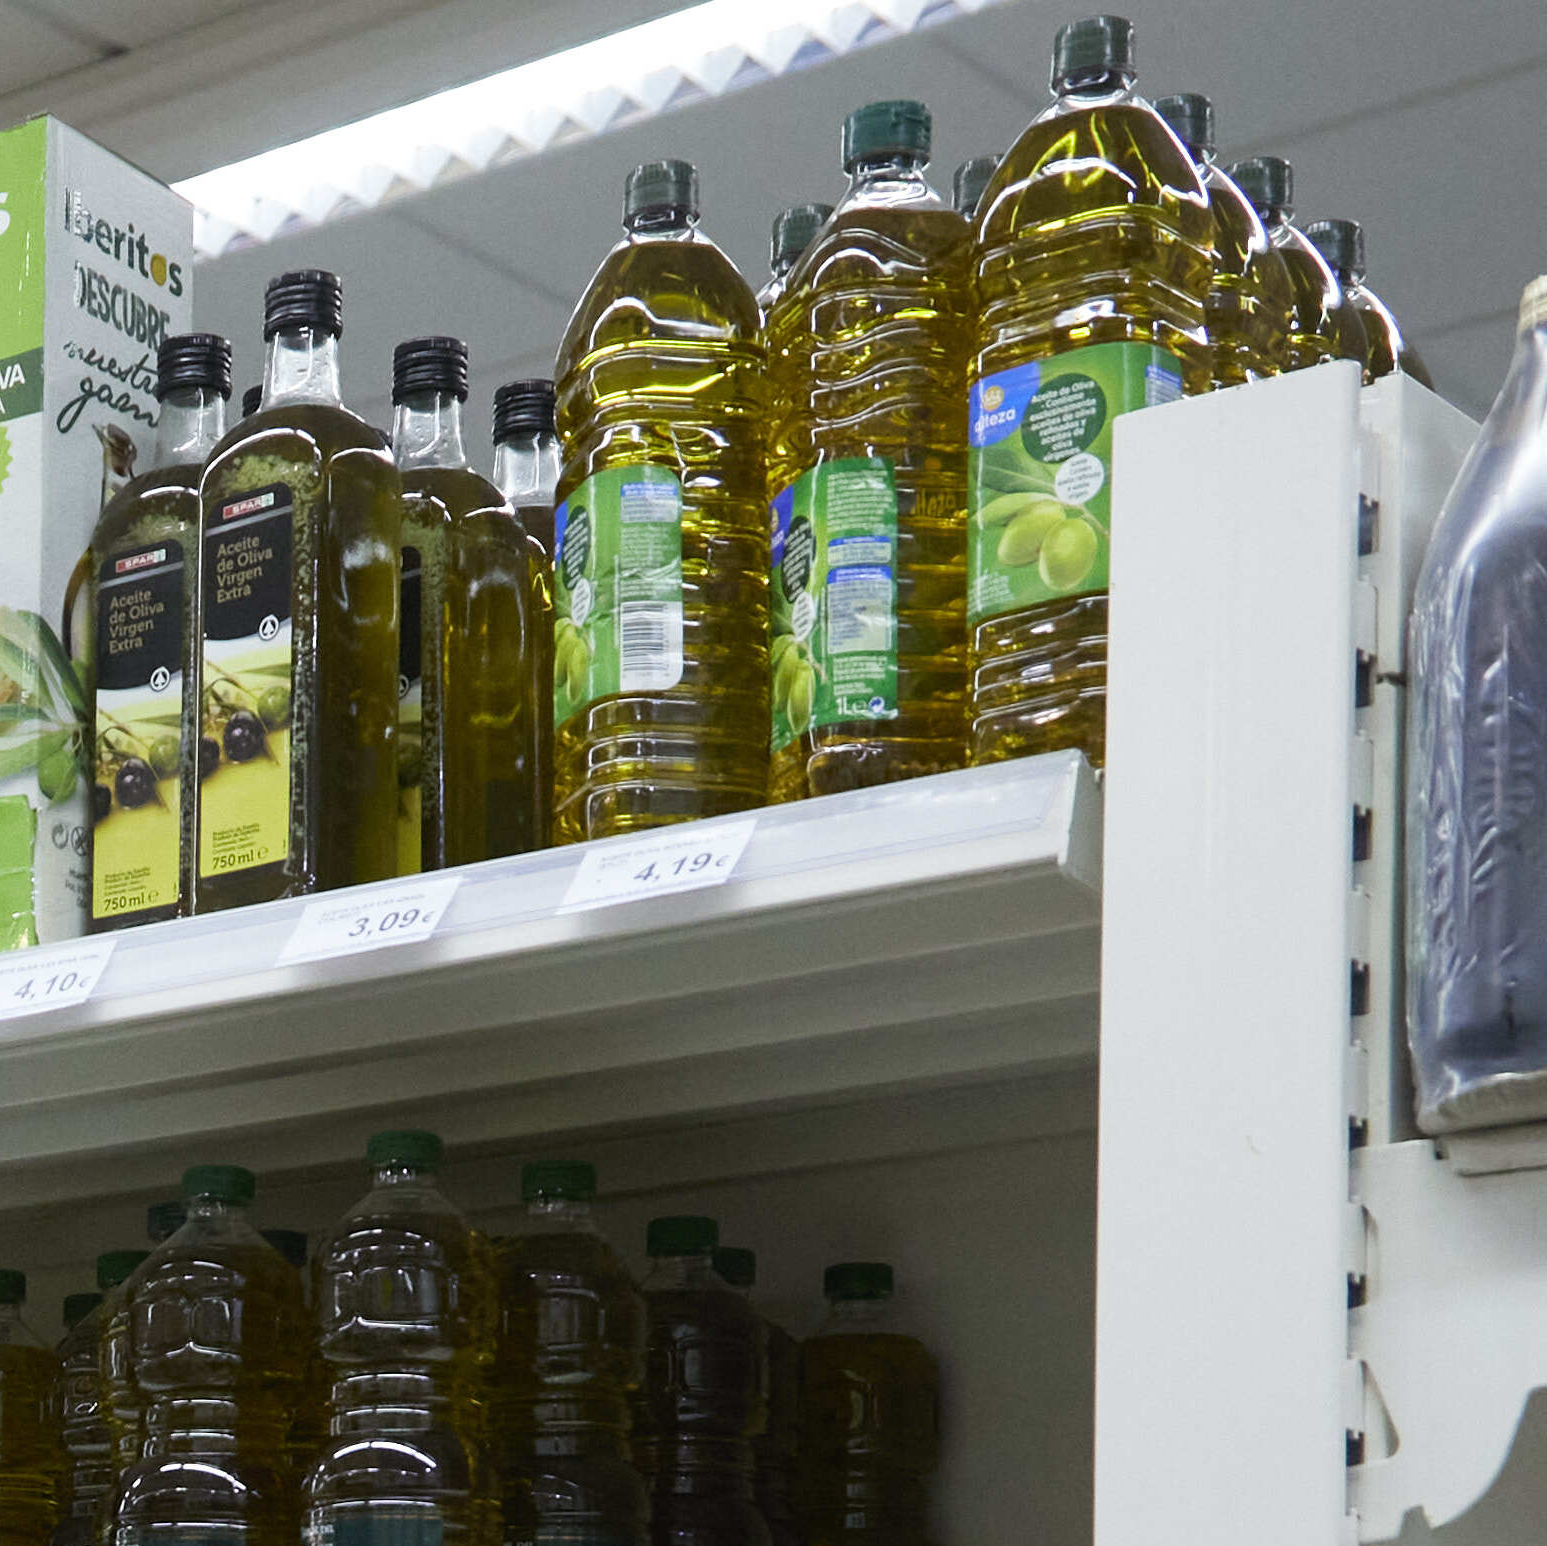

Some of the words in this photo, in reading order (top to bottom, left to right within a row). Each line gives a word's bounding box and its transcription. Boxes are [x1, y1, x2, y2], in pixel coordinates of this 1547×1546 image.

[217, 536, 259, 557] Aceite
[217, 559, 233, 573] de
[237, 548, 273, 567] Oliva
[217, 565, 263, 587] Virgen
[110, 590, 152, 610] Aceite
[217, 586, 251, 604] Extra
[109, 611, 126, 625] de
[129, 602, 164, 620] Oliva
[110, 619, 154, 640] Virgen
[109, 636, 143, 654] Extra
